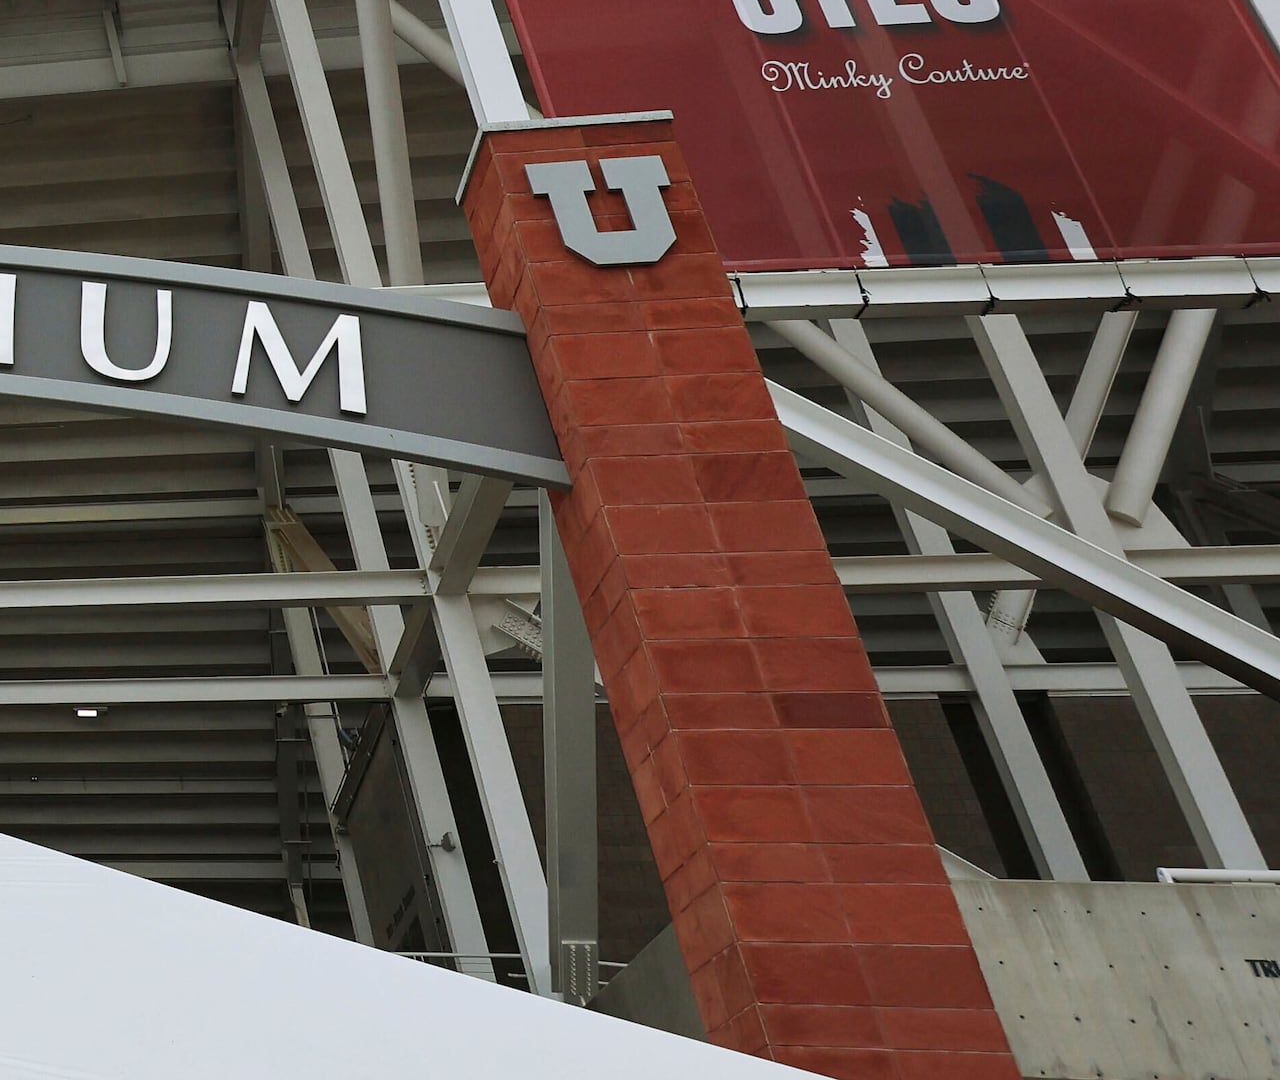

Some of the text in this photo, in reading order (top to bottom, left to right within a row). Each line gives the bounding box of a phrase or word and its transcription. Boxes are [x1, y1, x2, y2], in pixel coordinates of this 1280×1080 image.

[761, 53, 1029, 99] Minky Couture
[525, 154, 677, 266] U
